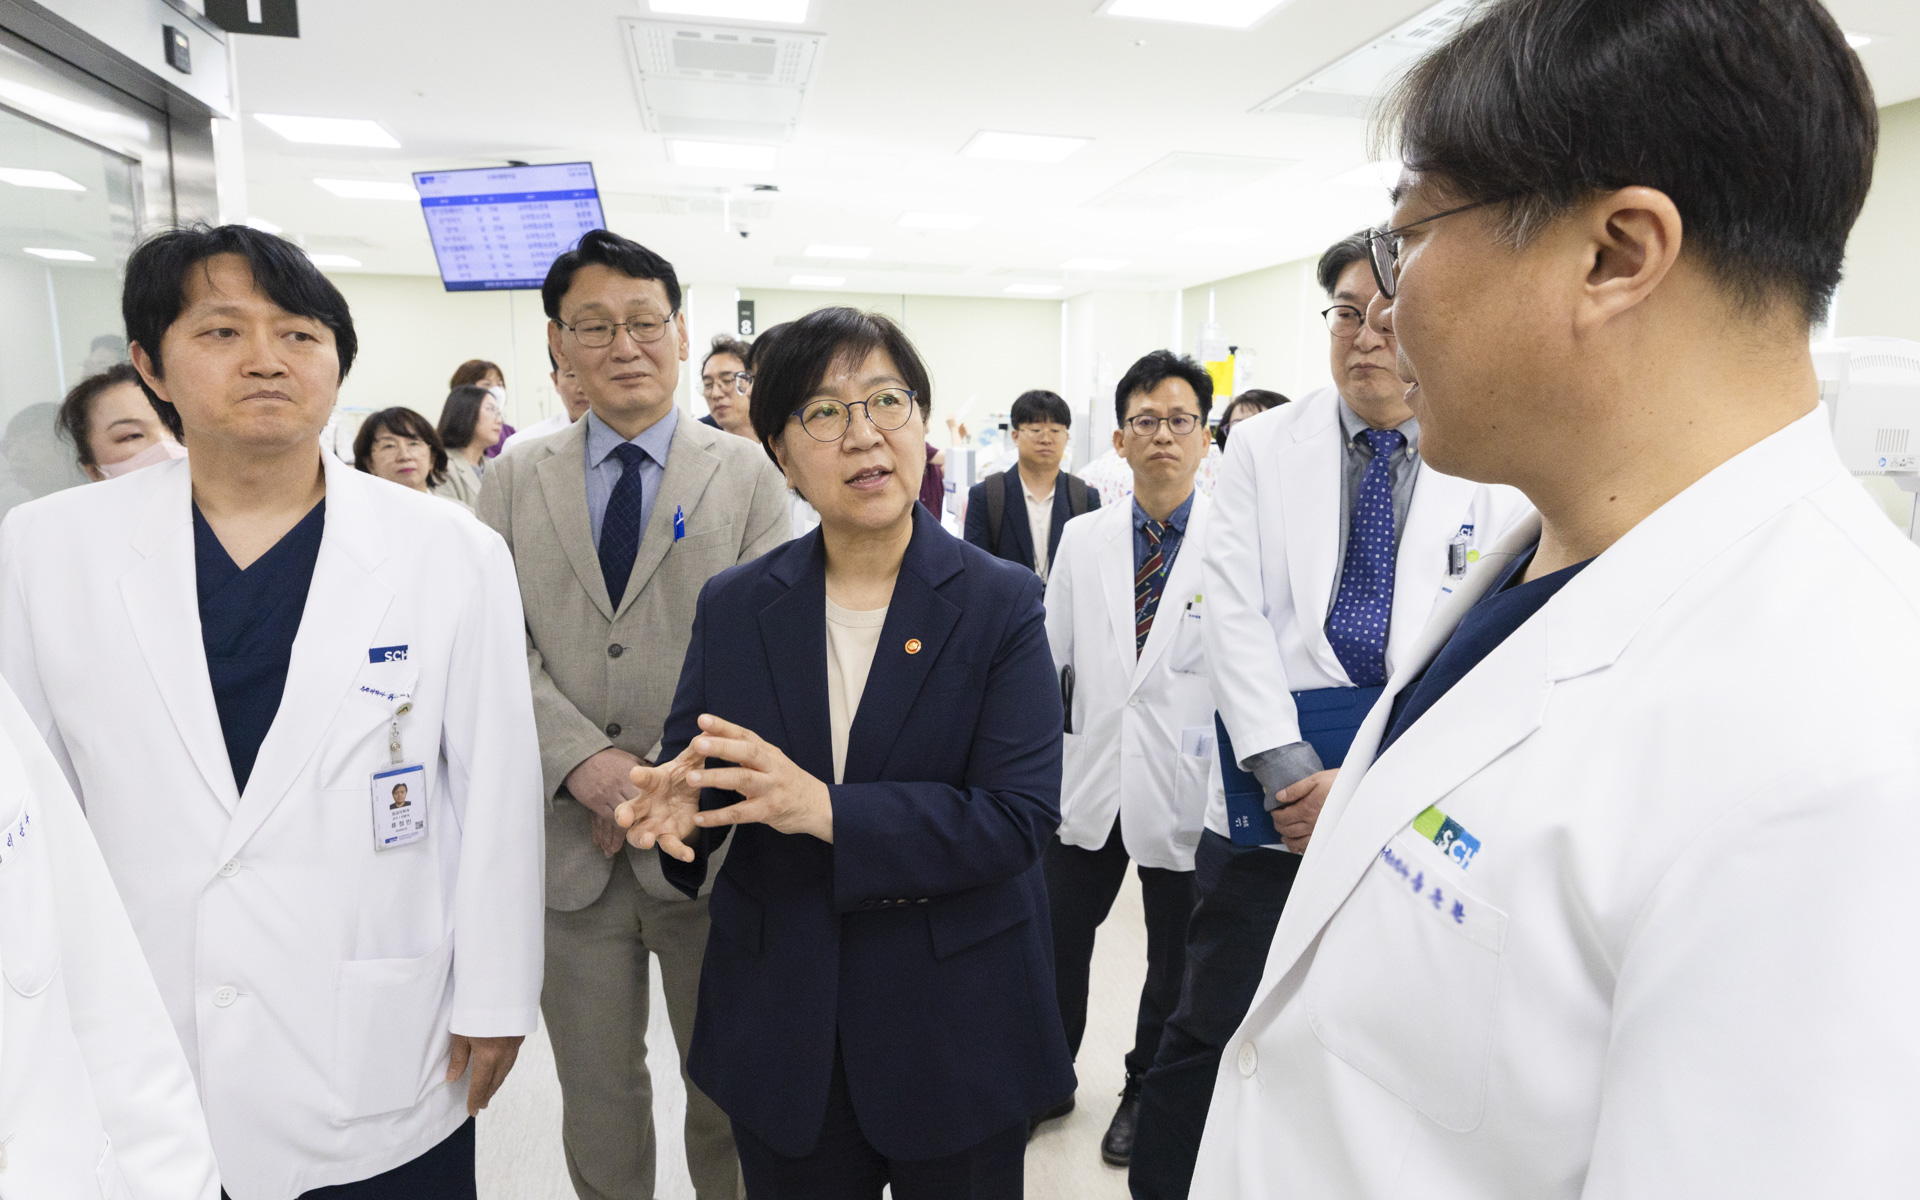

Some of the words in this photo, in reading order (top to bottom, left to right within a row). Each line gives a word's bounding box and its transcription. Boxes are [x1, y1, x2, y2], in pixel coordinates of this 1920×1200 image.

[741, 320, 752, 335] 8
[384, 650, 408, 662] SCH
[1438, 829, 1476, 872] SCH
